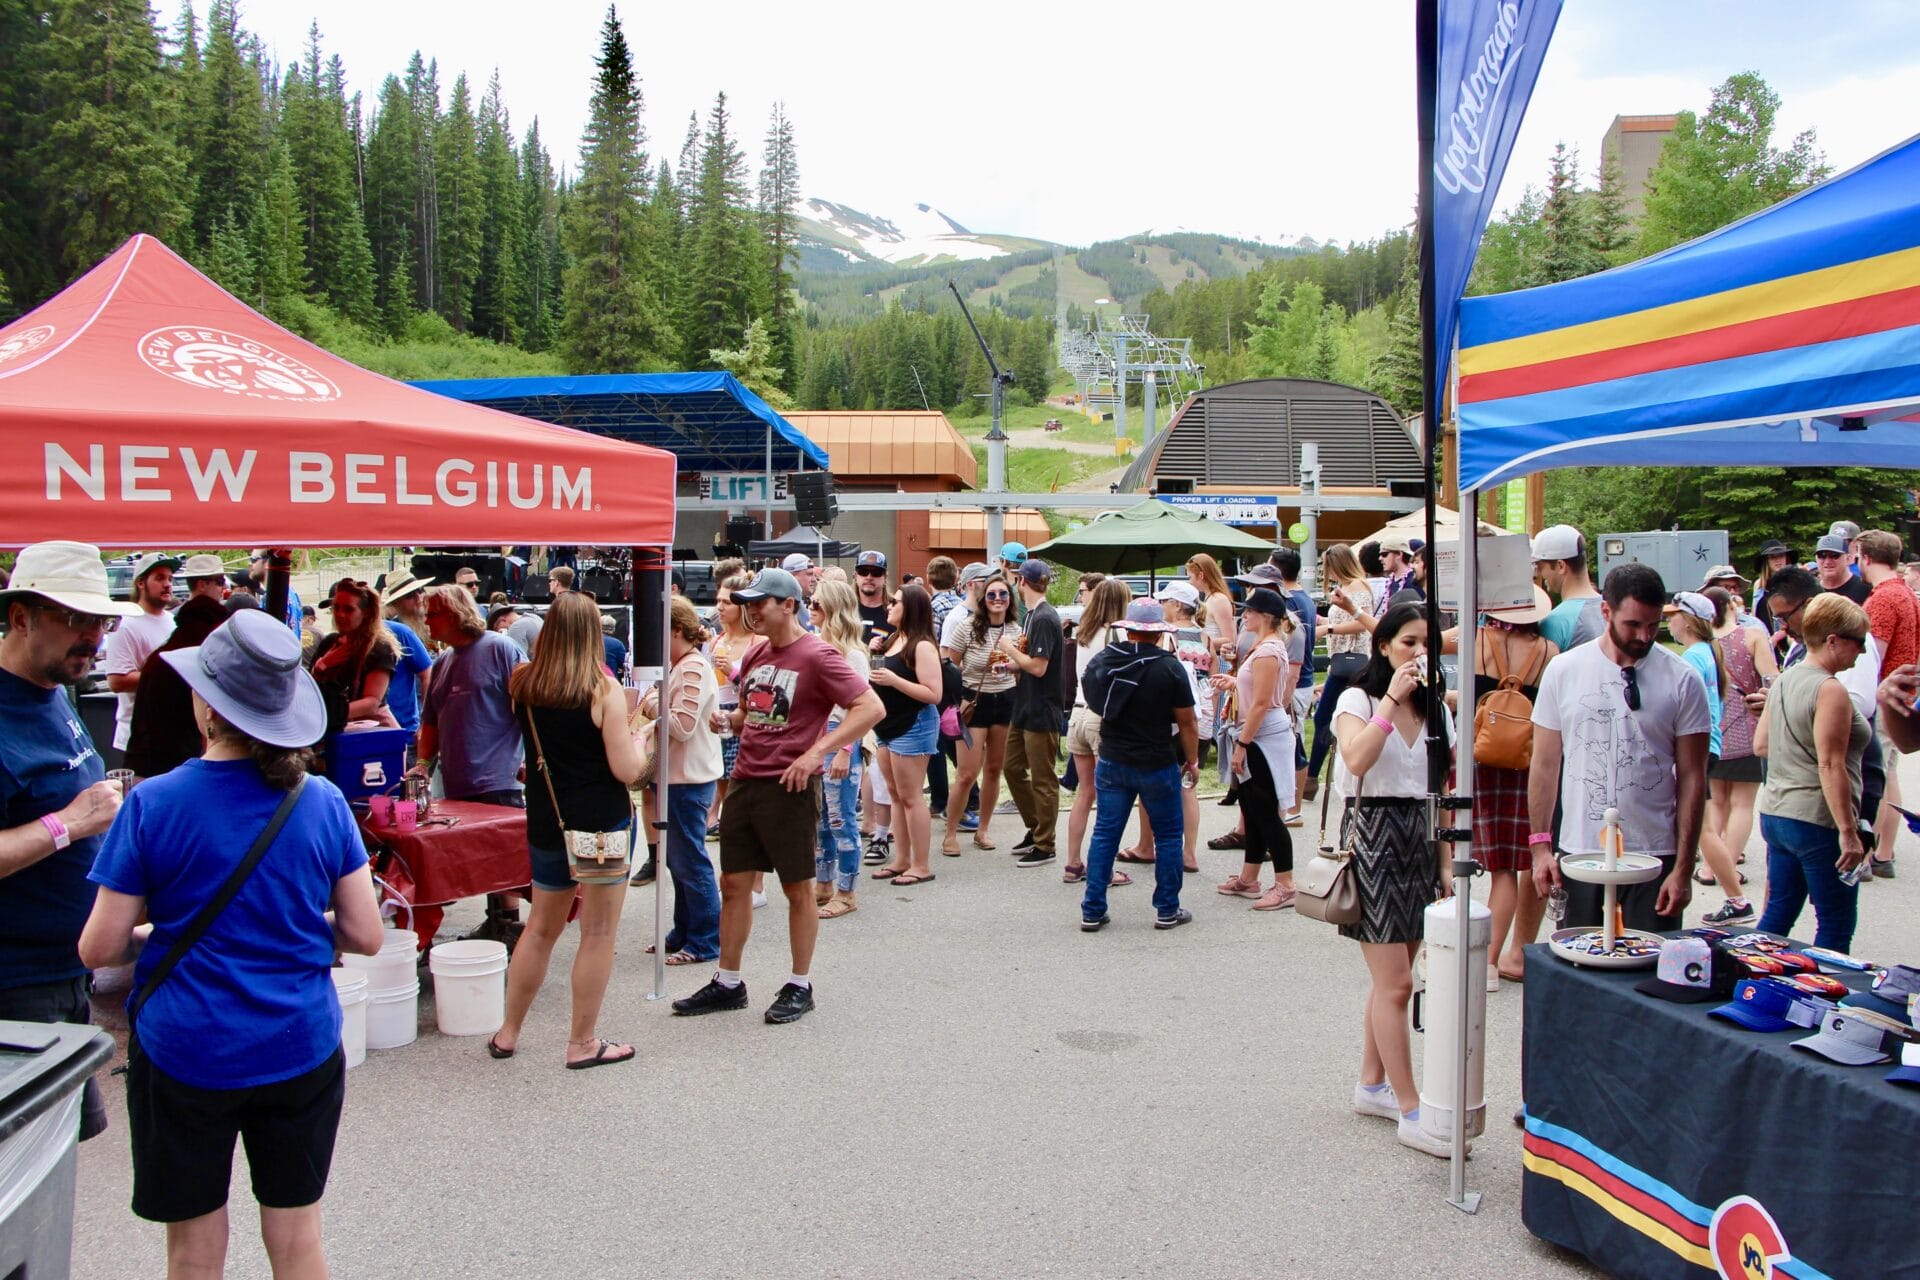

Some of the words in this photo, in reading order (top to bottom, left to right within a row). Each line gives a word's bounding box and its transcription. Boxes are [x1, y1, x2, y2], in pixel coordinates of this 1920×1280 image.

[148, 336, 175, 369] NEW
[173, 330, 321, 380] BELGIUM
[44, 442, 258, 503] NEW
[288, 450, 593, 512] BELGIUM
[700, 476, 711, 500] THE
[712, 476, 767, 500] LIFT
[774, 475, 787, 500] FM
[1224, 496, 1257, 504] LOADING
